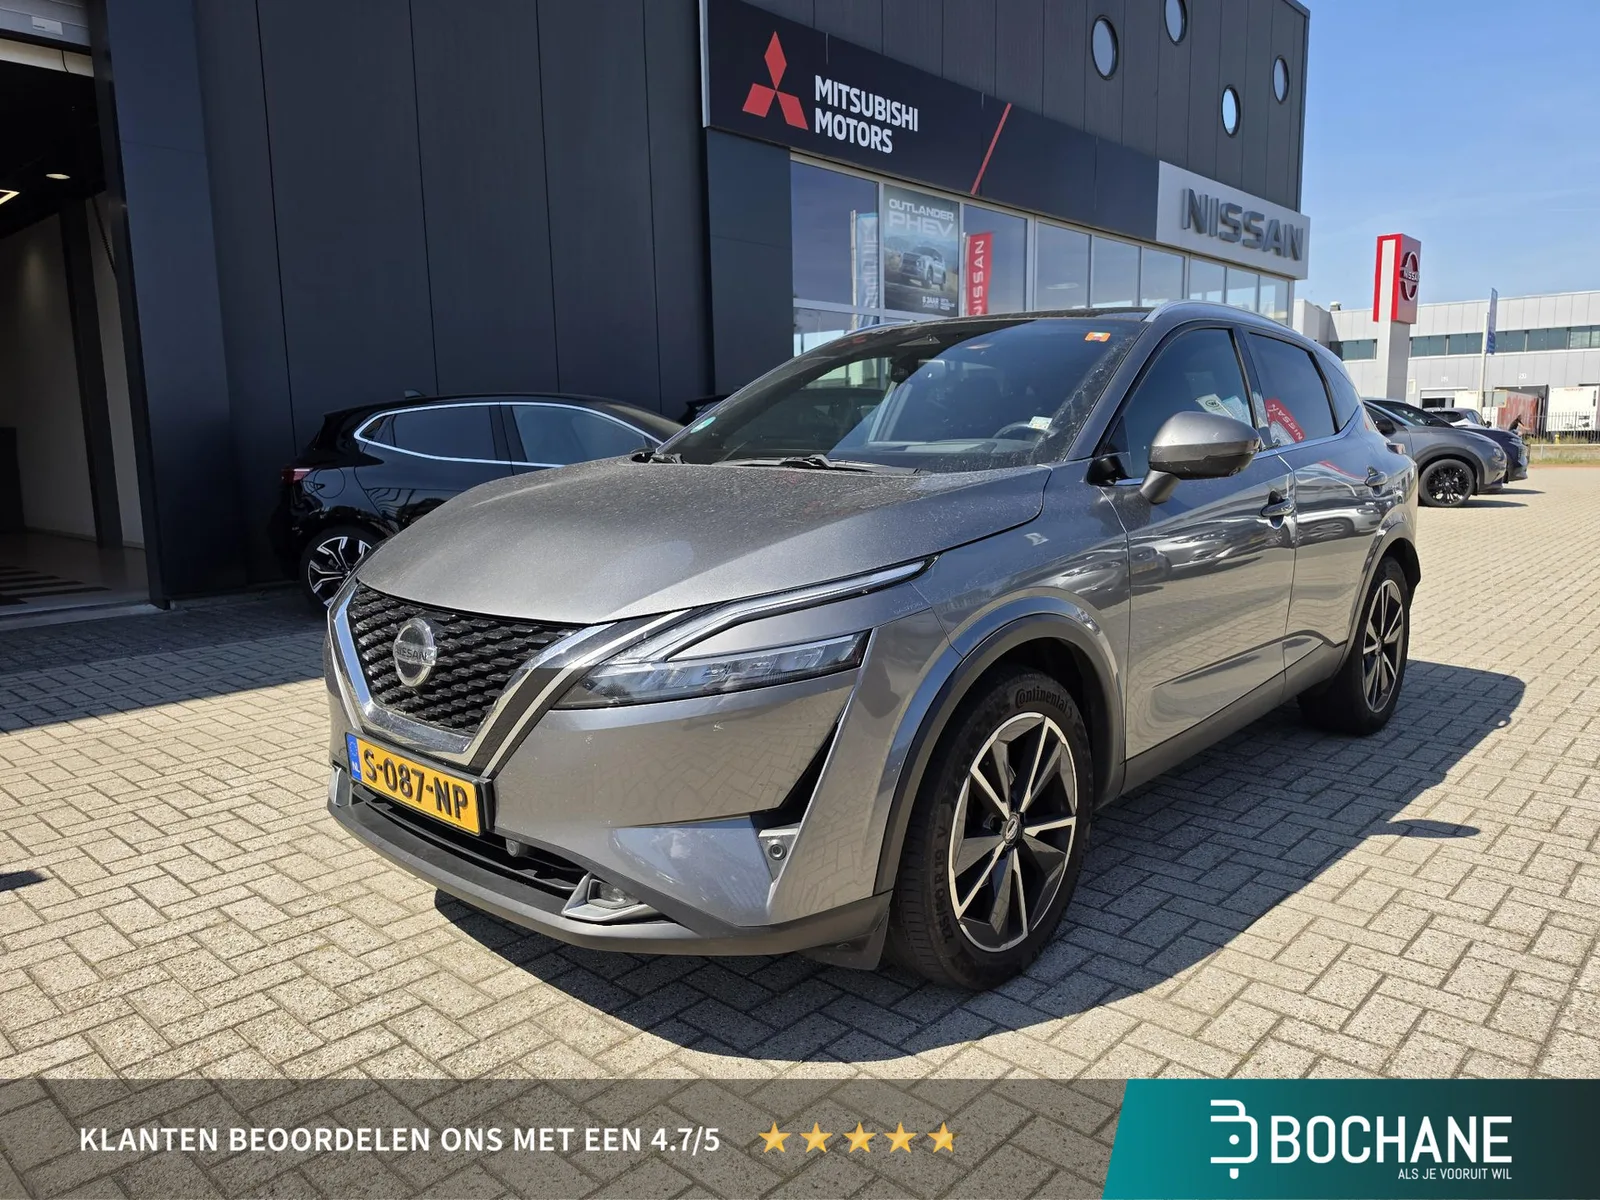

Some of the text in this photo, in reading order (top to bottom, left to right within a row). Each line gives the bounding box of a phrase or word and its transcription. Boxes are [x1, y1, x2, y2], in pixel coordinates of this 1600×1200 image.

[815, 74, 918, 132] MITSUBISHI
[815, 107, 893, 154] MOTORS
[888, 198, 954, 221] OUTLANDER
[888, 211, 954, 238] PHEV
[1181, 188, 1304, 262] NISSAN
[973, 240, 985, 315] NISSAN
[394, 647, 427, 661] NISSAN
[1015, 685, 1068, 713] Continental
[363, 748, 469, 819] S-087-NP
